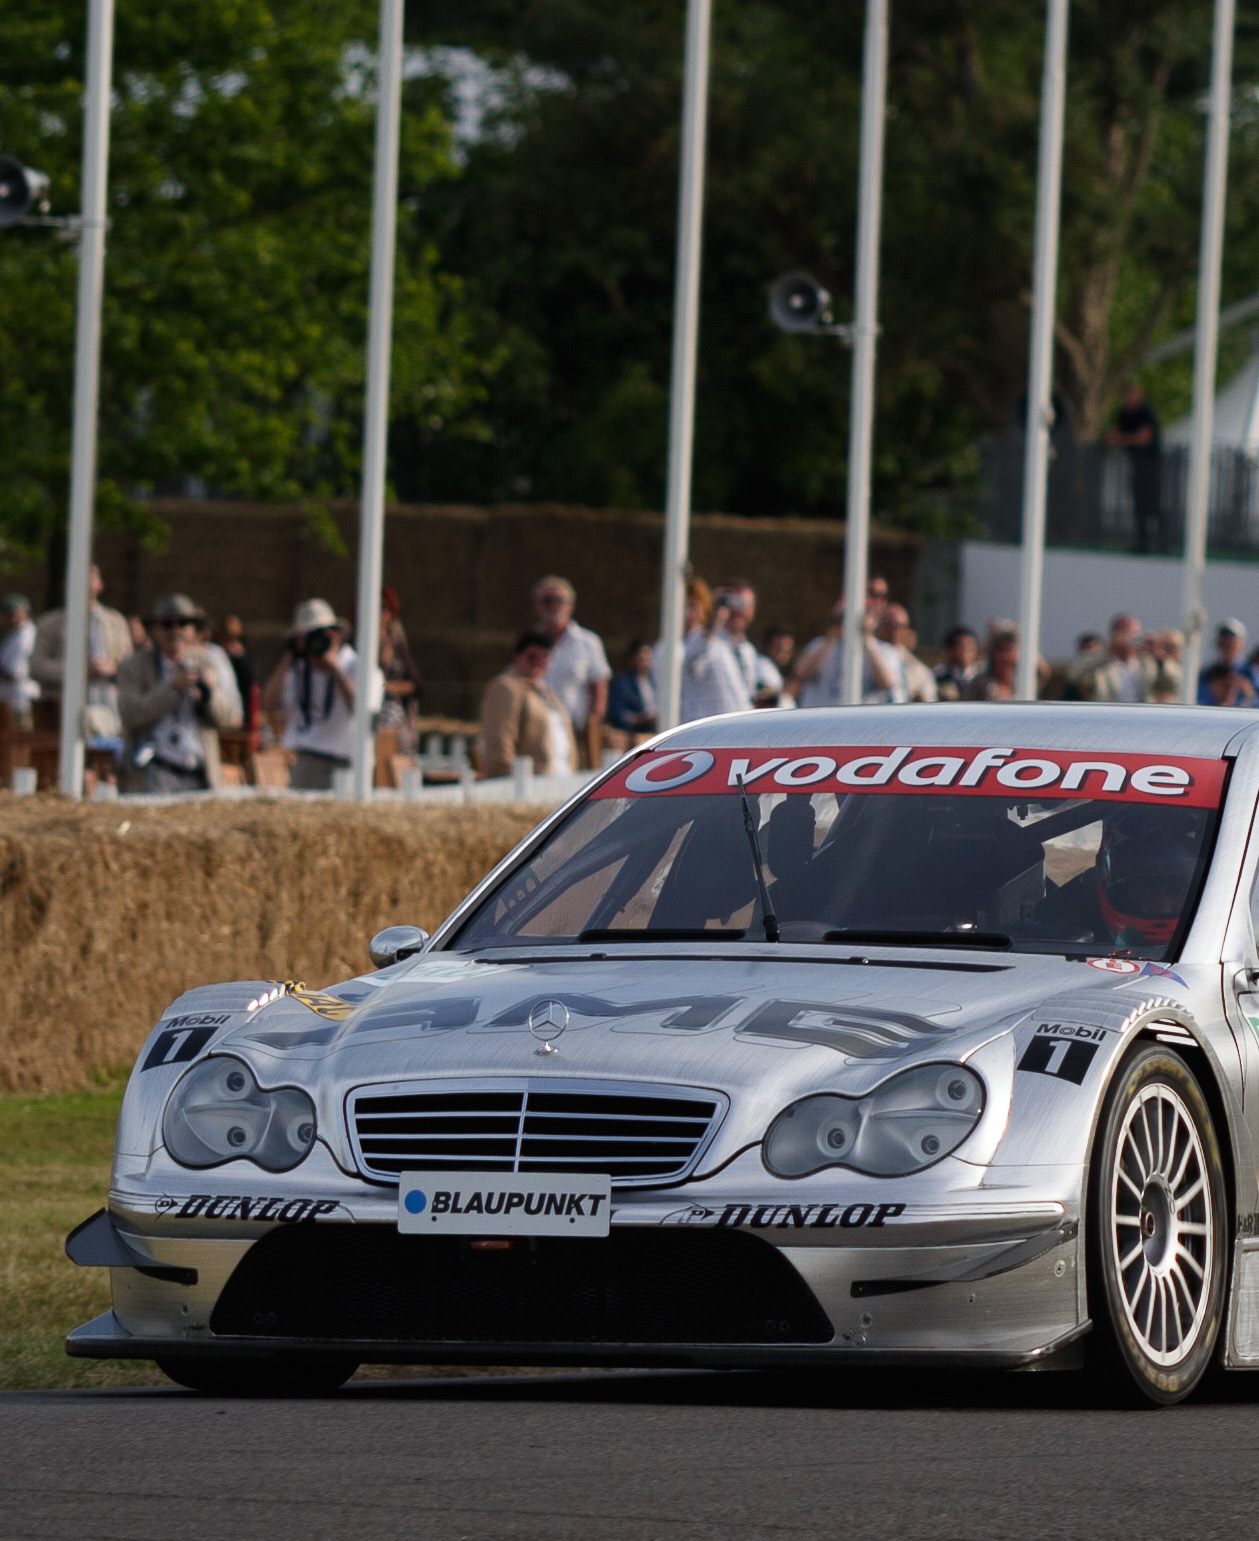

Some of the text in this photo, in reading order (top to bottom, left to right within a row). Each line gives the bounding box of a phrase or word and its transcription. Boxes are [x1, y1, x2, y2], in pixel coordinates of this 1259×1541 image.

[727, 746, 1192, 796] vodafone
[165, 1015, 231, 1029] Mobil
[1036, 1023, 1108, 1041] Mobil
[163, 1029, 194, 1062] 1
[1044, 1040, 1072, 1074] 1
[174, 1195, 341, 1223] DUNLOP
[431, 1191, 606, 1216] BLAUPUNKT
[713, 1203, 907, 1228] DUNLOP
